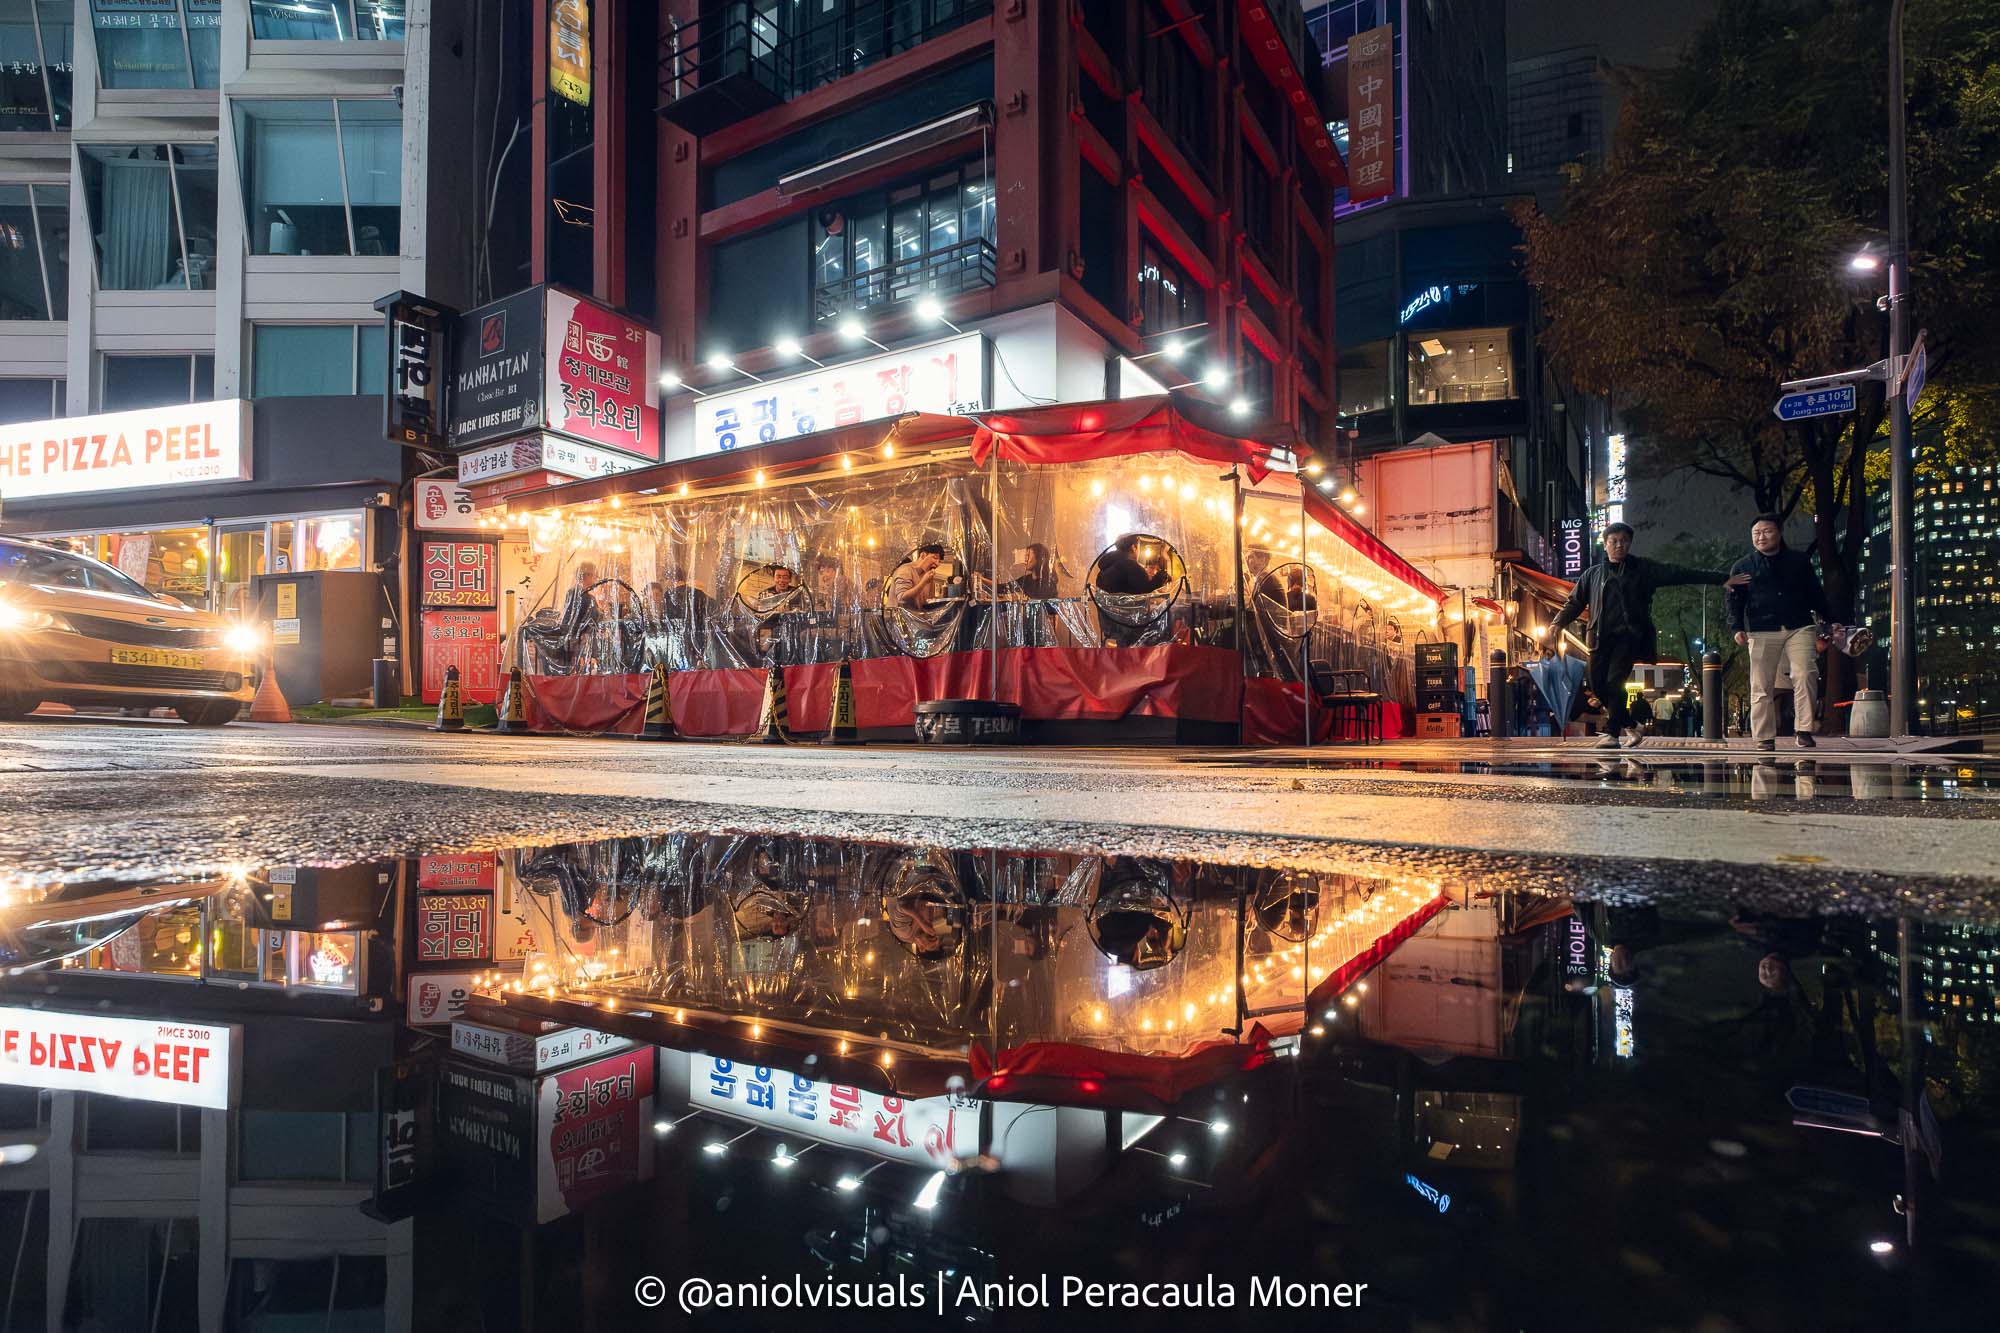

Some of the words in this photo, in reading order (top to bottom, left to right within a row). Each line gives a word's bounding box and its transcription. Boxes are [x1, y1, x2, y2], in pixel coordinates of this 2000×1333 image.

[101, 14, 141, 26] 지혜의
[150, 14, 176, 28] 공간
[1353, 75, 1385, 187] 中國料理
[625, 327, 644, 344] 2F
[458, 351, 529, 393] MANHATTAN
[565, 356, 631, 394] 청계면관
[458, 418, 477, 436] JACK
[478, 413, 500, 430] LIVES
[501, 406, 522, 423] HERE
[43, 432, 132, 474] PIZZA
[145, 424, 220, 464] PEEL
[197, 464, 220, 476] 2010
[470, 451, 509, 475] 냉삼겹살
[1561, 519, 1582, 529] MG
[426, 544, 489, 568] 지하
[1565, 529, 1581, 576] HOTEL
[429, 568, 486, 591] 임대
[425, 591, 491, 605] 735-2734
[485, 632, 497, 641] 2F
[971, 716, 1014, 736] TERRA
